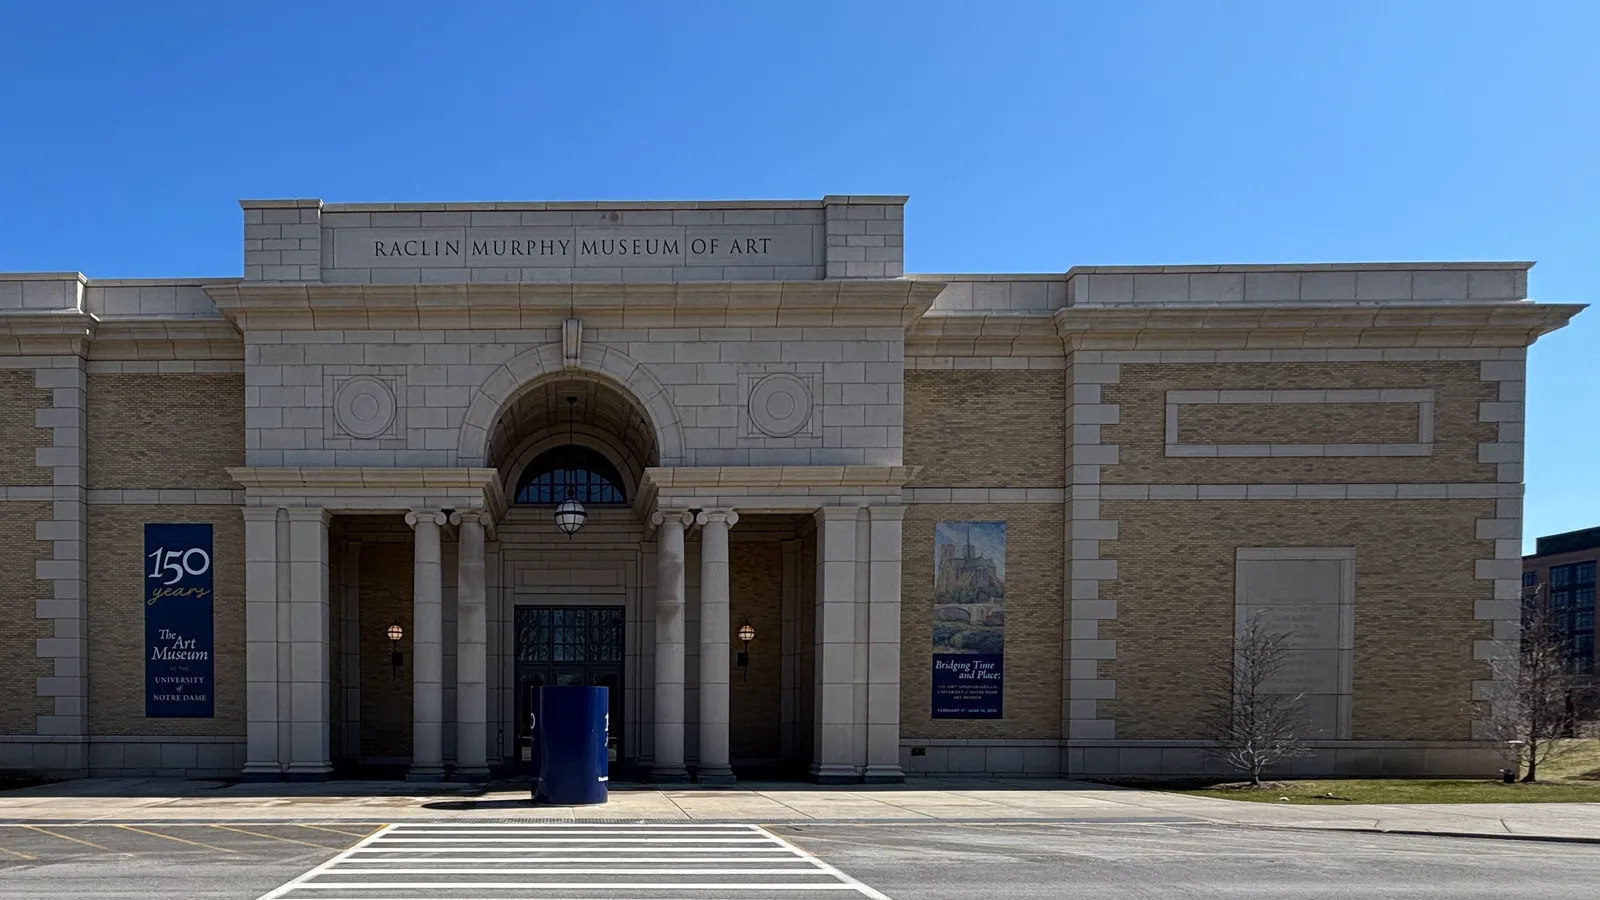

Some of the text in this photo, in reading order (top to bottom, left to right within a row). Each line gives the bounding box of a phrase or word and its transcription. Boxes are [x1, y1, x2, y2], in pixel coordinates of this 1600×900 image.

[375, 238, 772, 256] RACLIN MURPHY MUSEUM OF ART
[148, 547, 210, 585] 150
[147, 588, 211, 605] years
[159, 629, 177, 640] The
[172, 635, 197, 650] Art
[151, 646, 208, 661] Museum
[935, 660, 995, 672] Bridging Time
[155, 676, 205, 684] UNIVERSITY
[959, 670, 1000, 679] and Place:
[176, 685, 184, 693] of
